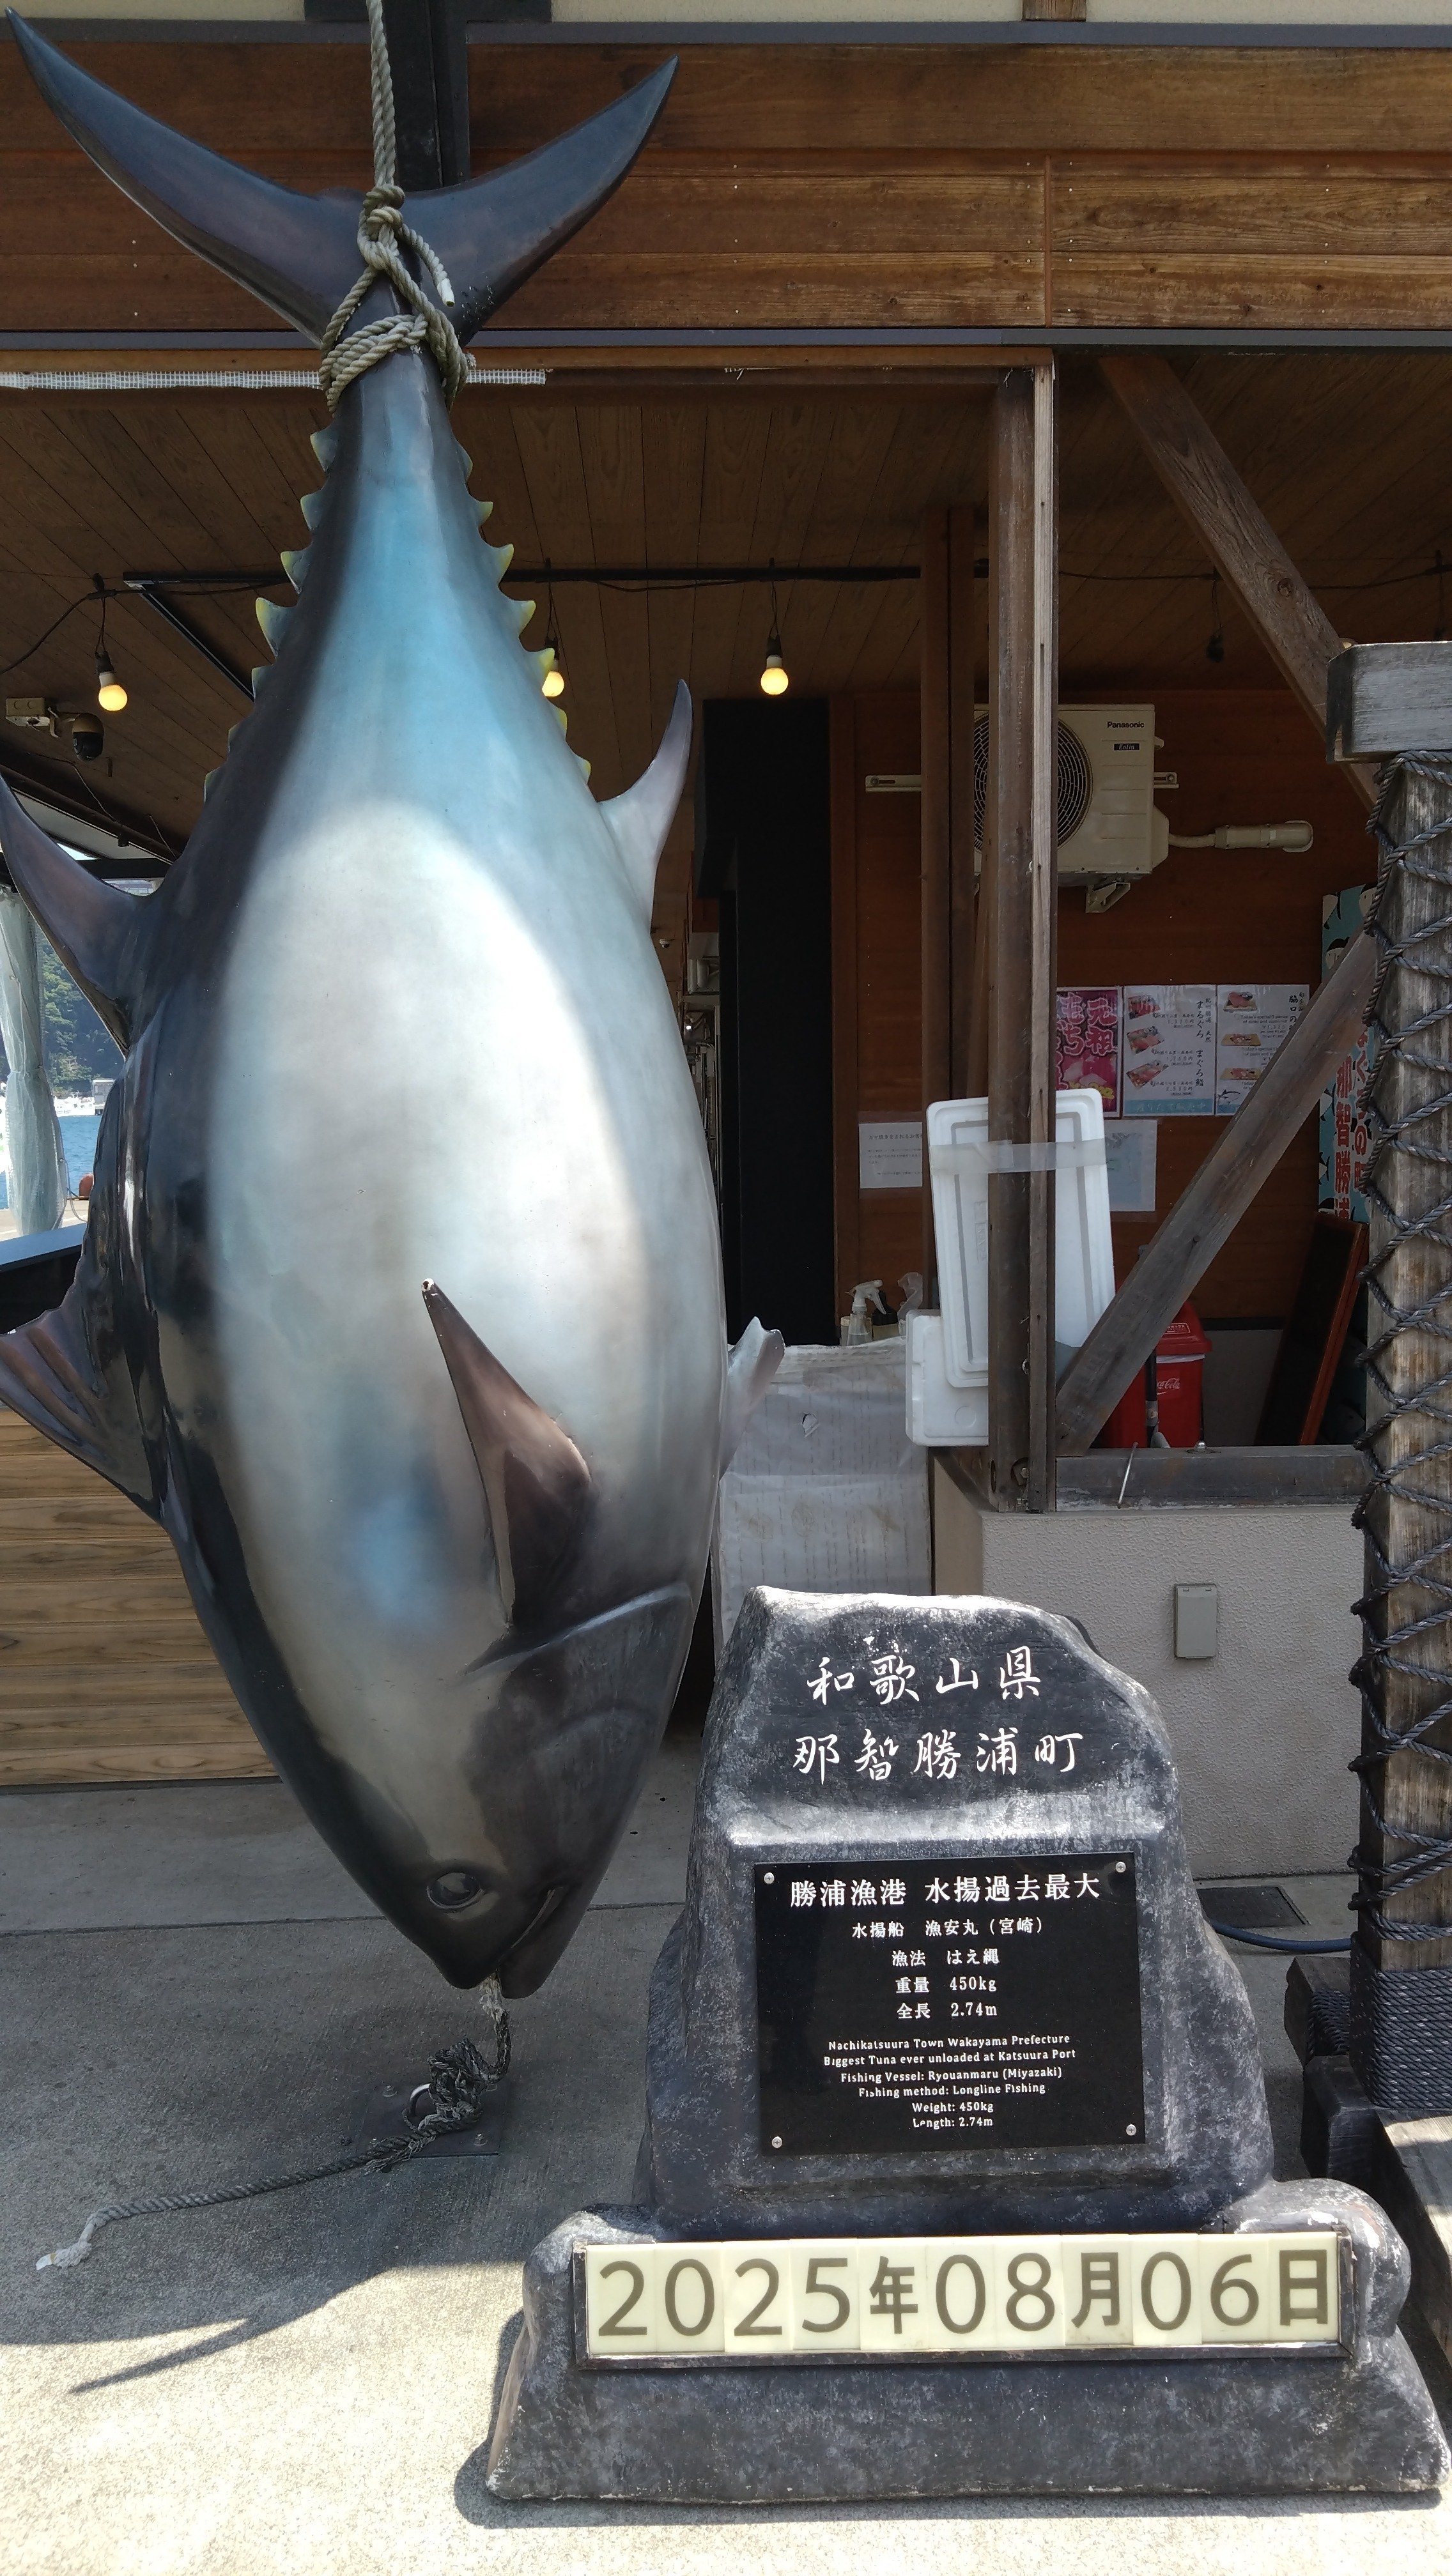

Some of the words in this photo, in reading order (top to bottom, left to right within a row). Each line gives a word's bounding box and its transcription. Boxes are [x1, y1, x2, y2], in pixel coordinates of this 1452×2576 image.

[1086, 997, 1118, 1056] 元祖
[806, 1646, 1041, 1705] 和歌山県
[792, 1727, 1084, 1785] 那智勝浦町
[791, 1878, 906, 1908] 勝浦漁港
[924, 1873, 1101, 1904] 水揚過去最大
[852, 1920, 904, 1939] 水揚船
[892, 1950, 926, 1967] 漁法
[946, 1948, 1000, 1965] はえ縄
[895, 1977, 930, 1993] 重量
[949, 1976, 997, 1991] 450kg
[896, 2002, 931, 2020] 全長
[950, 2002, 998, 2018] 2.74m
[828, 2040, 909, 2051] Nachikatsuura
[913, 2039, 944, 2048] Town
[947, 2037, 1008, 2048] Wakayama
[1012, 2034, 1070, 2044] Prefecture
[824, 2056, 865, 2068] Biggest
[868, 2055, 897, 2065] Tuna
[900, 2055, 925, 2064] ever
[928, 2052, 980, 2063] unloaded
[984, 2052, 994, 2062] at
[998, 2051, 1049, 2061] Katsuura
[1052, 2049, 1076, 2059] Port
[840, 2072, 882, 2084] Fishing
[884, 2071, 924, 2082] Vessel:
[928, 2071, 999, 2082] Ryouanmaru
[1003, 2066, 1062, 2080] (Miyazaki)
[858, 2087, 900, 2099] Fishing
[903, 2085, 949, 2096] method:
[952, 2084, 1001, 2096] Longline
[1005, 2083, 1046, 2094] Fishing
[911, 2102, 955, 2113] Weight:
[959, 2101, 994, 2113] 450kg
[913, 2117, 955, 2130] Length:
[959, 2117, 993, 2126] 2.74m
[596, 2248, 1331, 2338] 2025年08月06日
